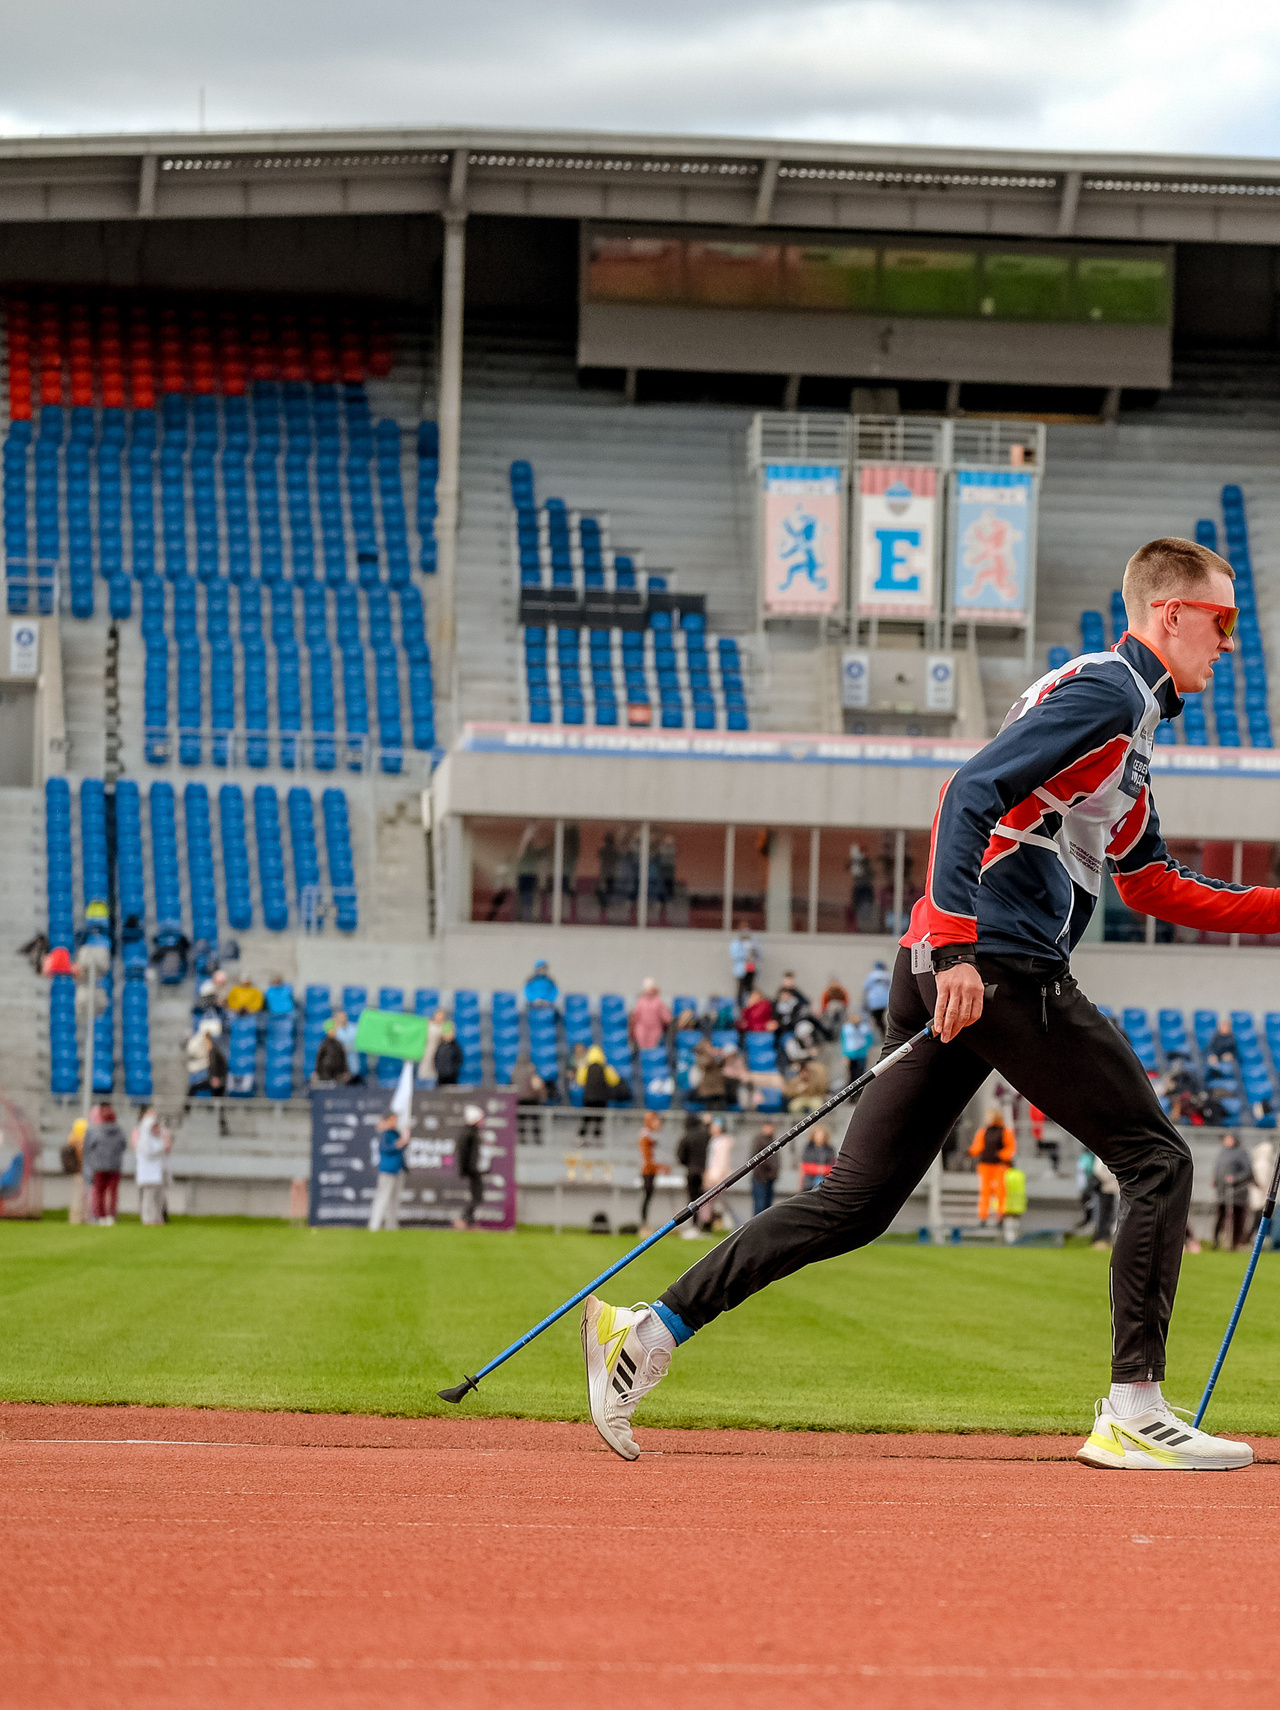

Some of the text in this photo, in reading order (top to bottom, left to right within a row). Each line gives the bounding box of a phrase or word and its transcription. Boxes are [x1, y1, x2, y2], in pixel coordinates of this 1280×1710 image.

[745, 1078, 862, 1168] НОВЫЙ ОБРАЗ ЖИЗНИ
